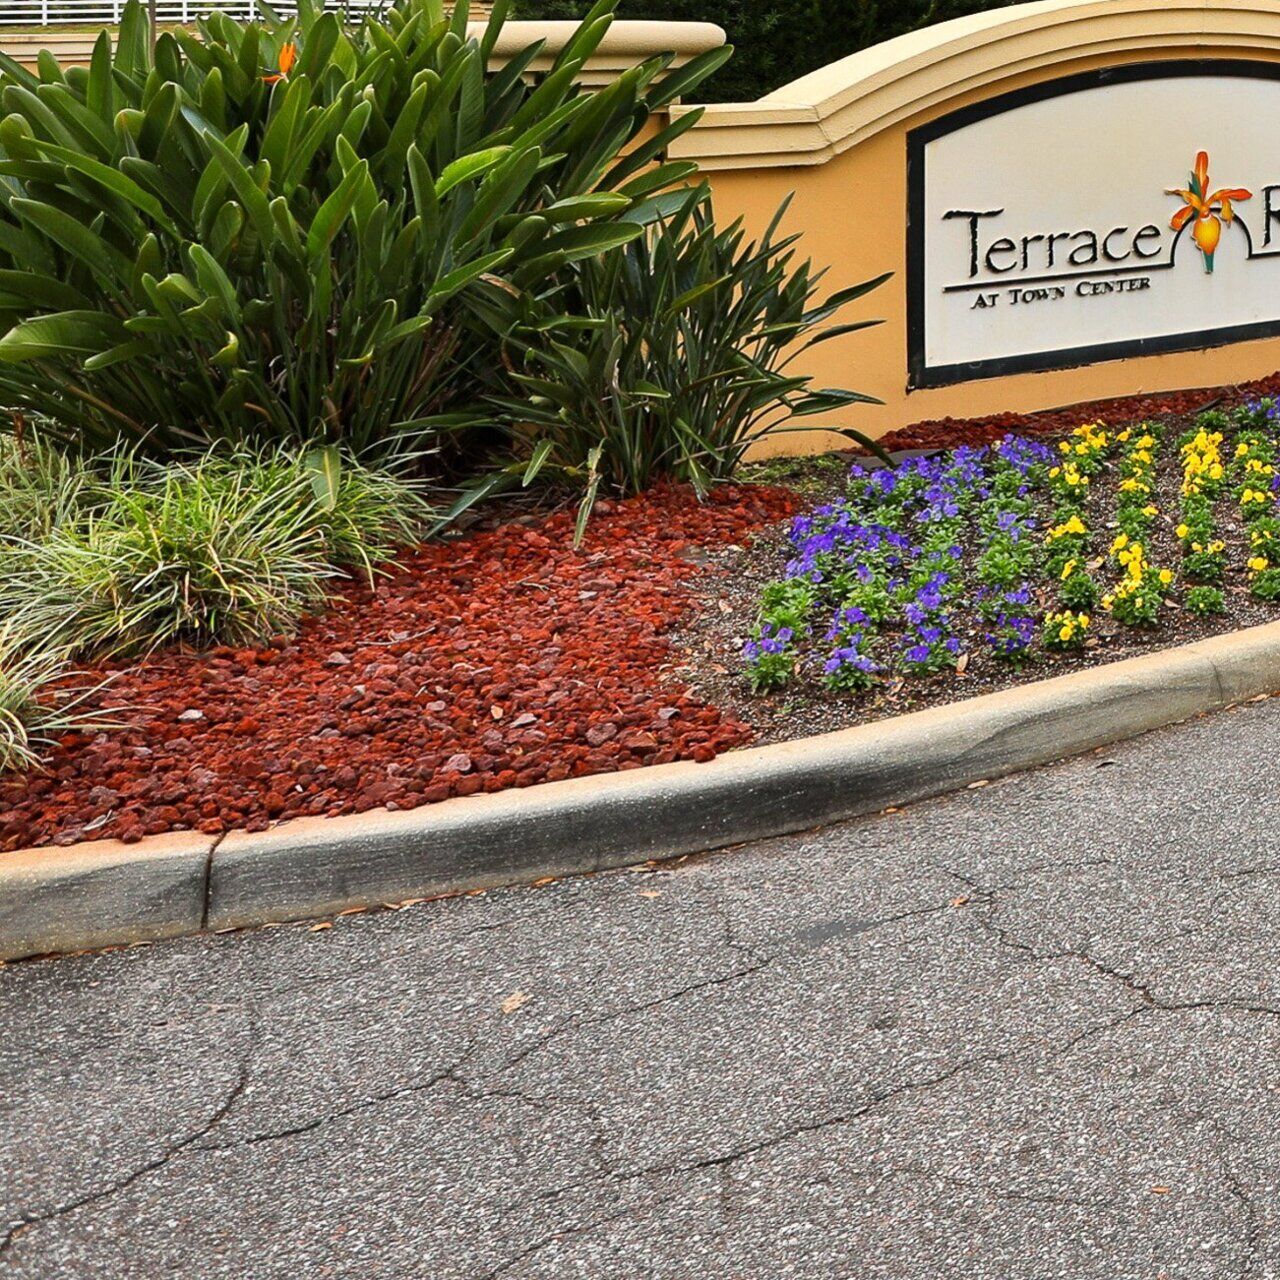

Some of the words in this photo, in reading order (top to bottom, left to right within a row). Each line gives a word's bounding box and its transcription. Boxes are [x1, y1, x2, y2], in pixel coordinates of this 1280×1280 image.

[942, 209, 1162, 277] Terrace
[970, 293, 999, 309] AT
[1008, 286, 1066, 305] TOWN
[1076, 277, 1151, 297] CENTER
